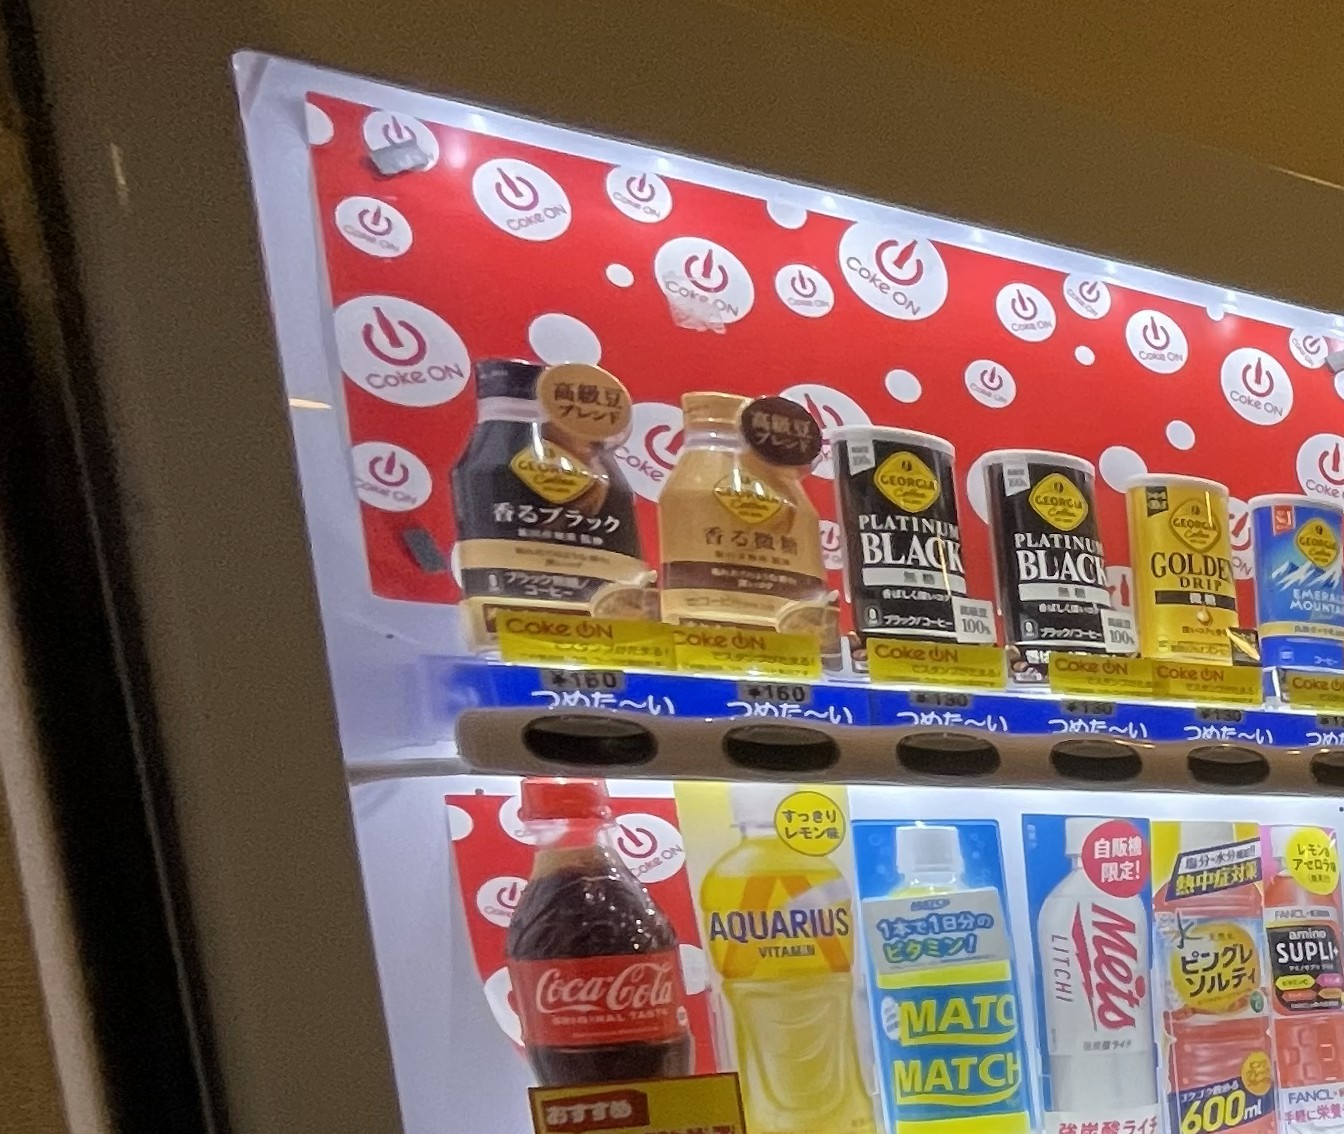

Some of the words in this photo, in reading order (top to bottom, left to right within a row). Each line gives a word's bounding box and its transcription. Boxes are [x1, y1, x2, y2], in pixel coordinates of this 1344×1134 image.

[507, 211, 544, 232] Coke
[544, 202, 567, 221] ON
[845, 256, 890, 295] Coke
[891, 289, 921, 316] ON
[366, 368, 425, 391] Coke
[426, 363, 464, 384] ON
[558, 402, 622, 427] ブレンド
[1230, 390, 1264, 411] Coke
[1265, 399, 1284, 417] ON
[613, 446, 665, 483] Coke
[880, 474, 936, 491] GEORGIA
[1034, 494, 1084, 510] GEORGIA
[493, 501, 621, 534] 香るブラック
[861, 532, 964, 574] BLACK
[1180, 576, 1222, 592] DRIP
[506, 617, 571, 638] Coke
[576, 623, 613, 640] ON
[874, 643, 926, 661] Coke
[928, 644, 960, 664] ON
[1157, 665, 1199, 681] Coke
[1200, 668, 1225, 682] ON
[896, 711, 1008, 733] つめた〜い
[1184, 725, 1273, 745] つめた〜い
[782, 807, 838, 824] すっきり
[783, 824, 840, 842] レモン味
[1092, 837, 1144, 859] 自販機
[1100, 859, 1142, 884] 限定!
[709, 906, 850, 943] AQUARIUS
[876, 910, 995, 940] 1本で1日分の
[758, 944, 816, 960] VITAMIN
[883, 933, 979, 961] ビタミン!
[1180, 943, 1255, 975] ピングレ
[1050, 933, 1075, 1004] LITCHI
[1090, 900, 1145, 1032] Mets
[534, 962, 674, 1015] Coca-Cola
[1184, 966, 1257, 998] ソルティ
[545, 1099, 633, 1127] おすすめ
